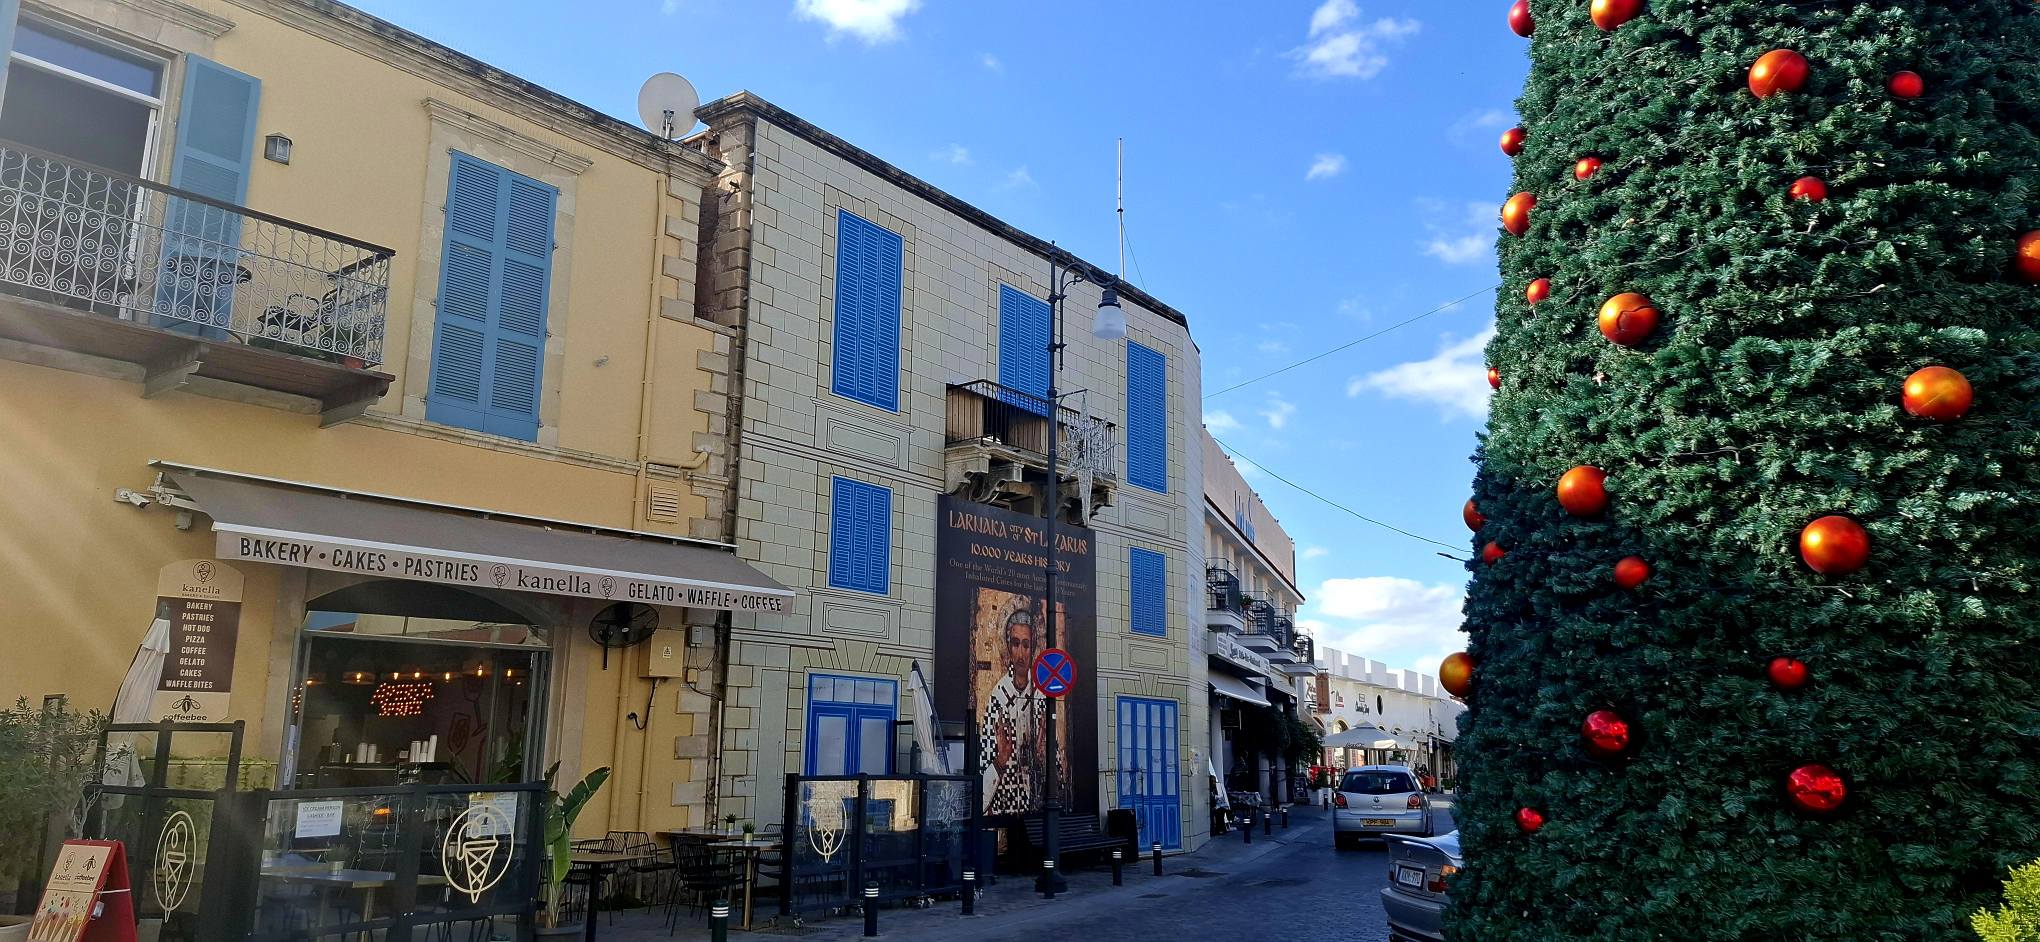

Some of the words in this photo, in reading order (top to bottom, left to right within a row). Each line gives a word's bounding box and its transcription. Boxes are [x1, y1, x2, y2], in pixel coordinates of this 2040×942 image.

[949, 510, 1008, 539] LARNAKA
[1040, 530, 1088, 555] LZARUS
[971, 543, 1001, 558] 10.000
[1004, 550, 1033, 566] YEARS
[1034, 556, 1071, 572] HISORY
[240, 538, 313, 563] BAKERY
[332, 548, 387, 572] CAKES
[404, 557, 479, 582] PASTRIES
[517, 569, 591, 594] kanella
[628, 582, 674, 602] GELATO
[687, 588, 730, 608] WAFFLE
[741, 595, 782, 612] COFFEE
[182, 584, 220, 594] kanella
[186, 601, 213, 611] BAKERY
[182, 612, 215, 622] PASTRIES
[182, 623, 197, 632] HOT
[197, 624, 211, 633] DOG
[185, 635, 205, 643] PIZZA
[181, 646, 207, 655] COFFEE
[179, 657, 205, 666] GELATO
[180, 669, 202, 677] CAKES
[165, 679, 193, 688] WAFFLE
[193, 681, 213, 689] BITES
[163, 713, 207, 721] coffeebee
